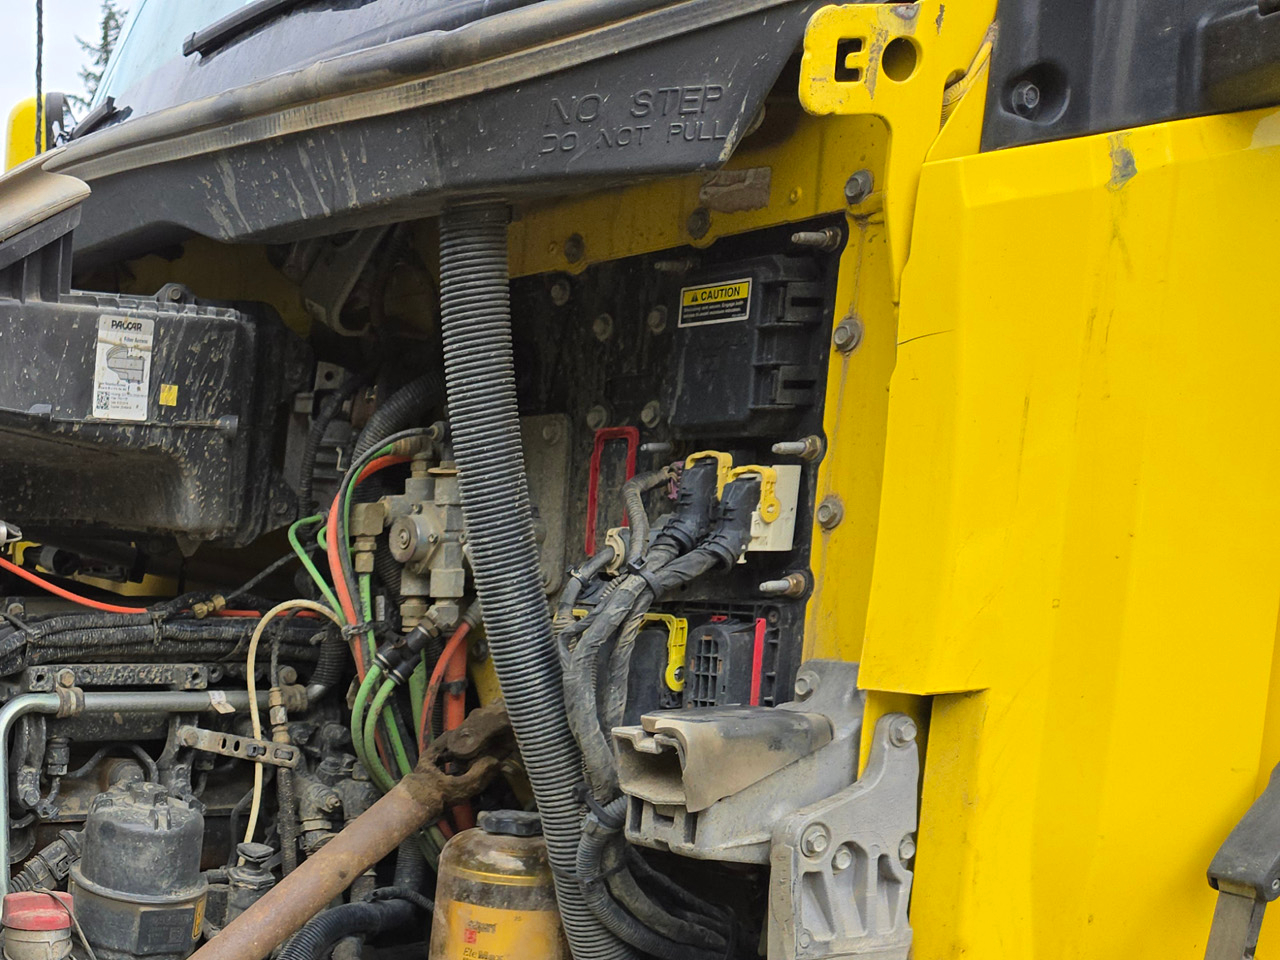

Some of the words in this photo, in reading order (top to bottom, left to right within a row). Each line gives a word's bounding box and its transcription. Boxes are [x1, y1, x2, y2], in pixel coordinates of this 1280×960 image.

[544, 93, 602, 127] NO
[631, 85, 724, 117] STEP
[539, 132, 578, 154] DO
[596, 125, 651, 149] NOT
[666, 121, 727, 143] PULL
[701, 286, 740, 301] CAUTION
[111, 320, 142, 332] PACCAR
